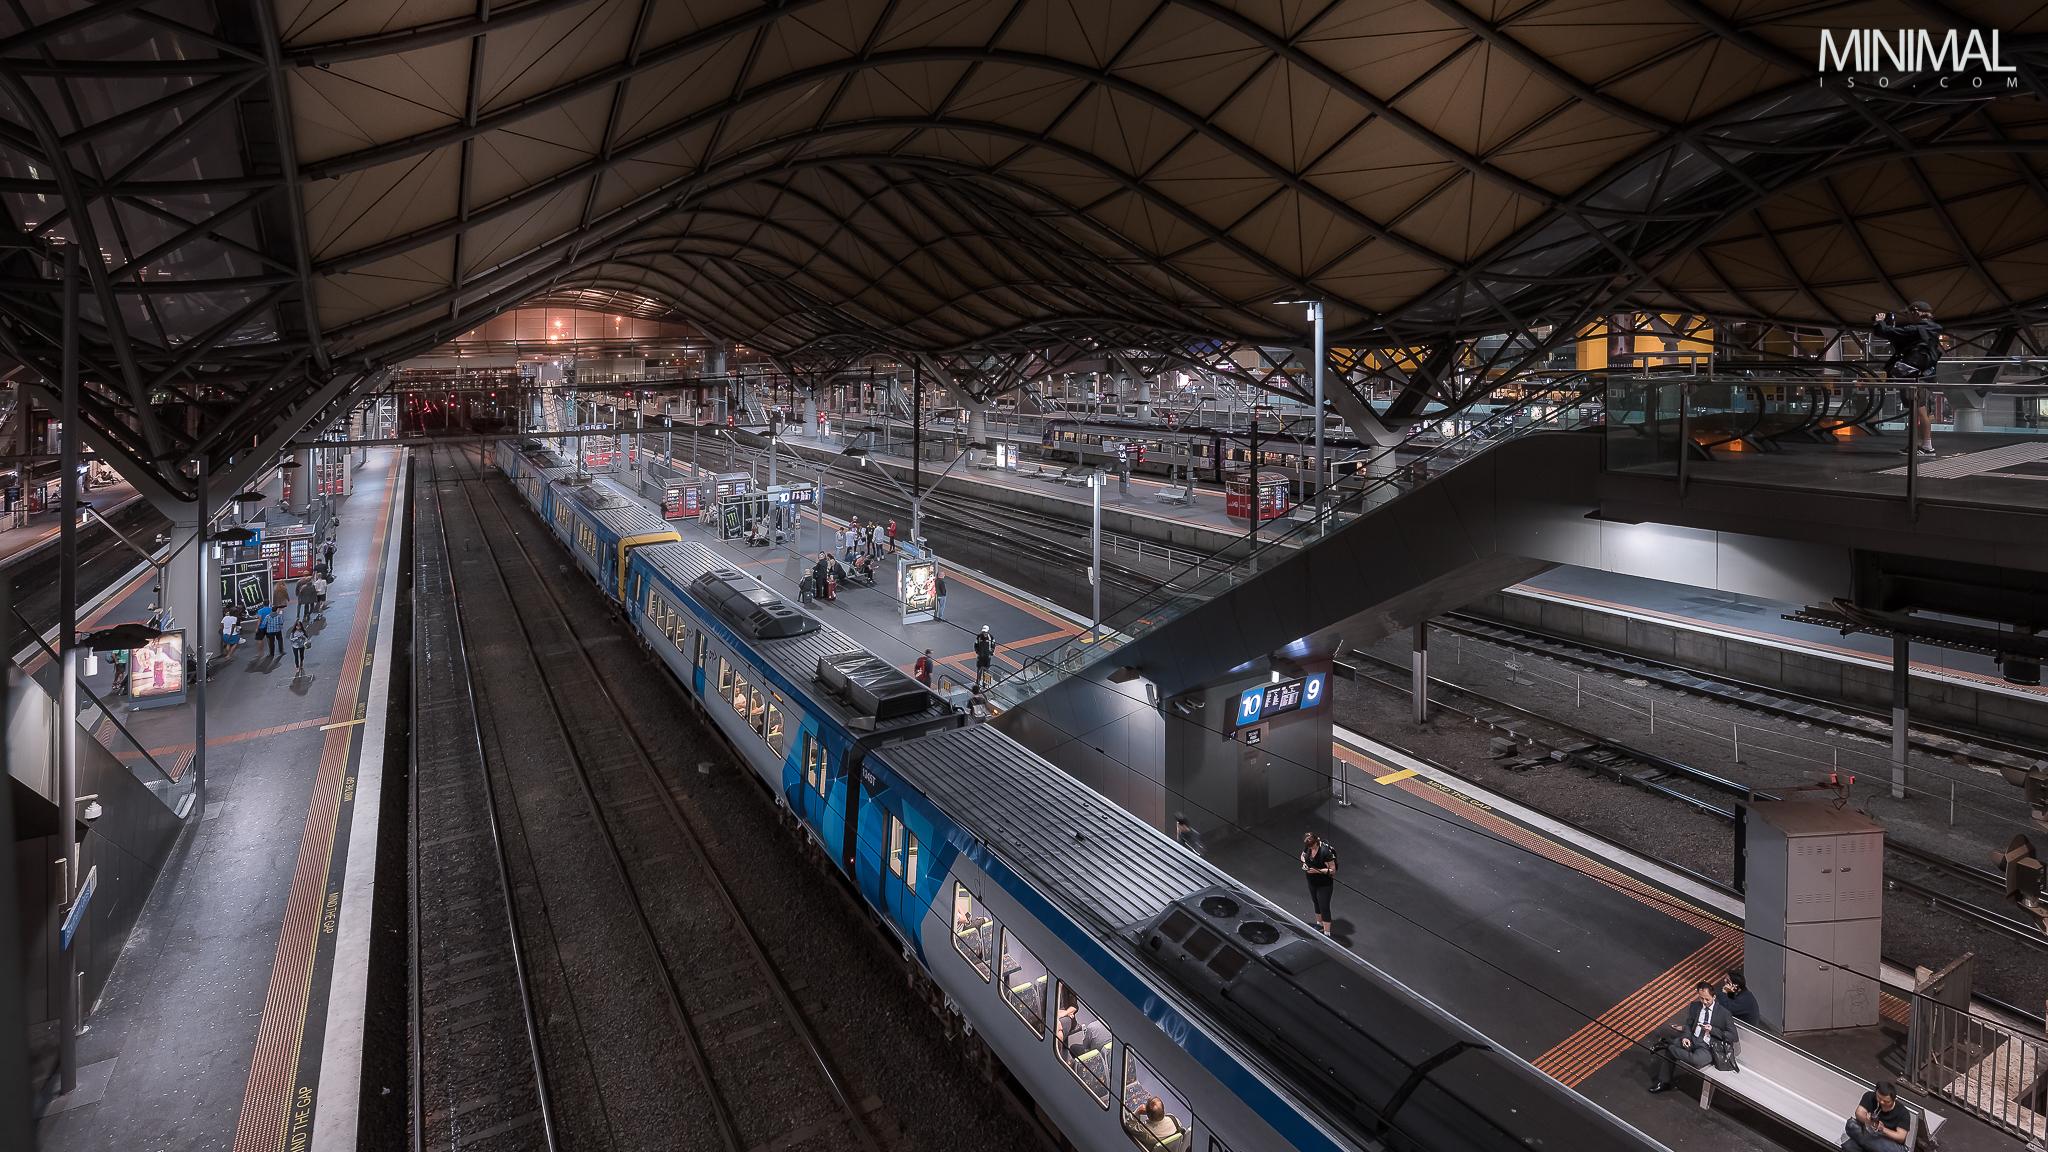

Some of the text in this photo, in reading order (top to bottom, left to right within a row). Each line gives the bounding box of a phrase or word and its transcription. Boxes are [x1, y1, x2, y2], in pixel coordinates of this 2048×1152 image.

[779, 492, 790, 503] 10
[1308, 680, 1319, 699] 9
[1243, 694, 1260, 716] 10
[1427, 781, 1491, 809] MIND THE GAP
[325, 908, 336, 920] THE
[323, 921, 334, 933] GAP
[290, 1087, 313, 1152] IND THE GAP
